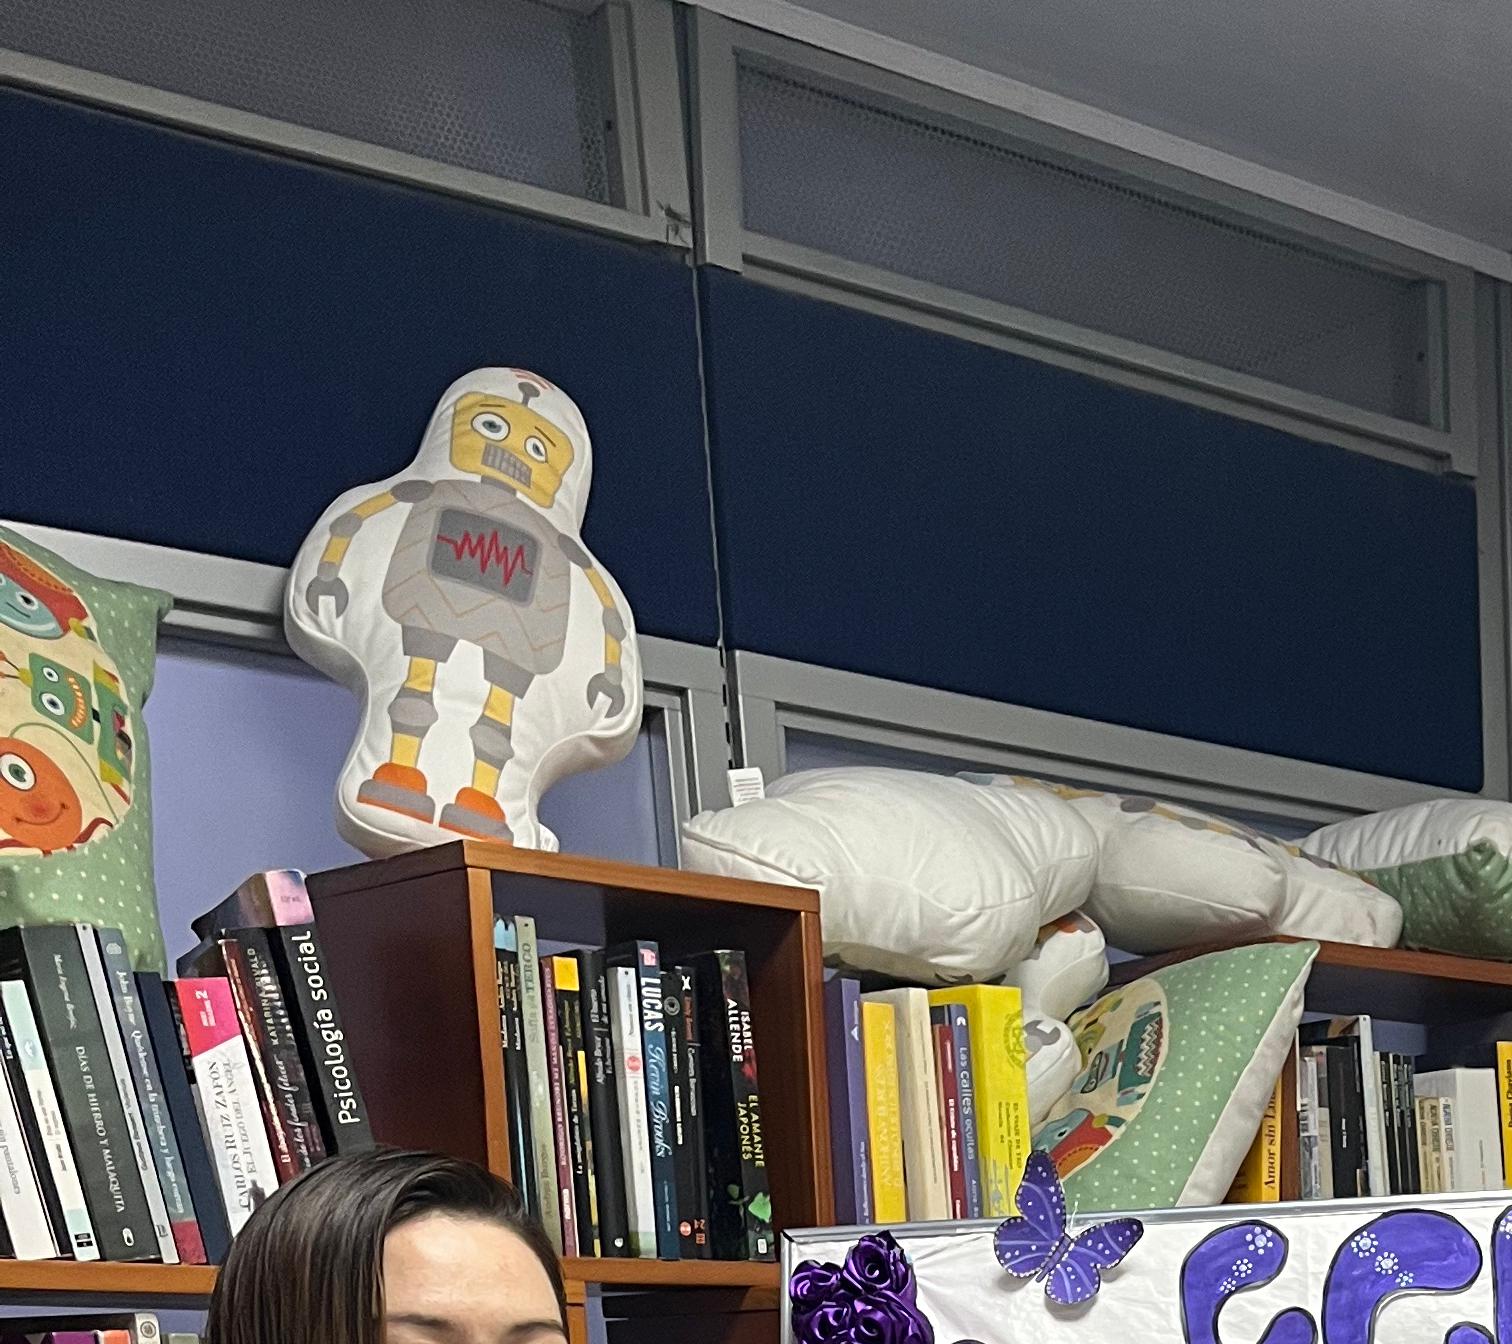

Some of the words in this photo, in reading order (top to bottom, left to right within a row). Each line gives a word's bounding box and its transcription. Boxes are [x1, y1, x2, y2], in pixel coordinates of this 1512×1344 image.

[289, 929, 331, 1004] social
[521, 942, 534, 992] TERCO
[640, 977, 664, 1032] LUCAS
[726, 998, 744, 1062] ALLENDE
[740, 1011, 753, 1051] ISABEL
[958, 1046, 969, 1067] Las
[81, 1073, 94, 1090] DE
[205, 1058, 228, 1109] ZAFÓN
[310, 1006, 365, 1126] Psicología
[649, 1044, 670, 1098] Kevin
[86, 1092, 107, 1137] HIERRO
[748, 1094, 757, 1110] EL
[98, 1137, 109, 1147] Y
[218, 1112, 238, 1150] RUIZ
[654, 1099, 673, 1158] Brooks
[737, 1102, 752, 1161] JAPONÉS
[750, 1111, 765, 1167] AMANTE
[1264, 1123, 1276, 1145] sin
[100, 1147, 126, 1213] MALAQUITA
[227, 1152, 252, 1209] CARLOS
[1264, 1149, 1276, 1187] Amor
